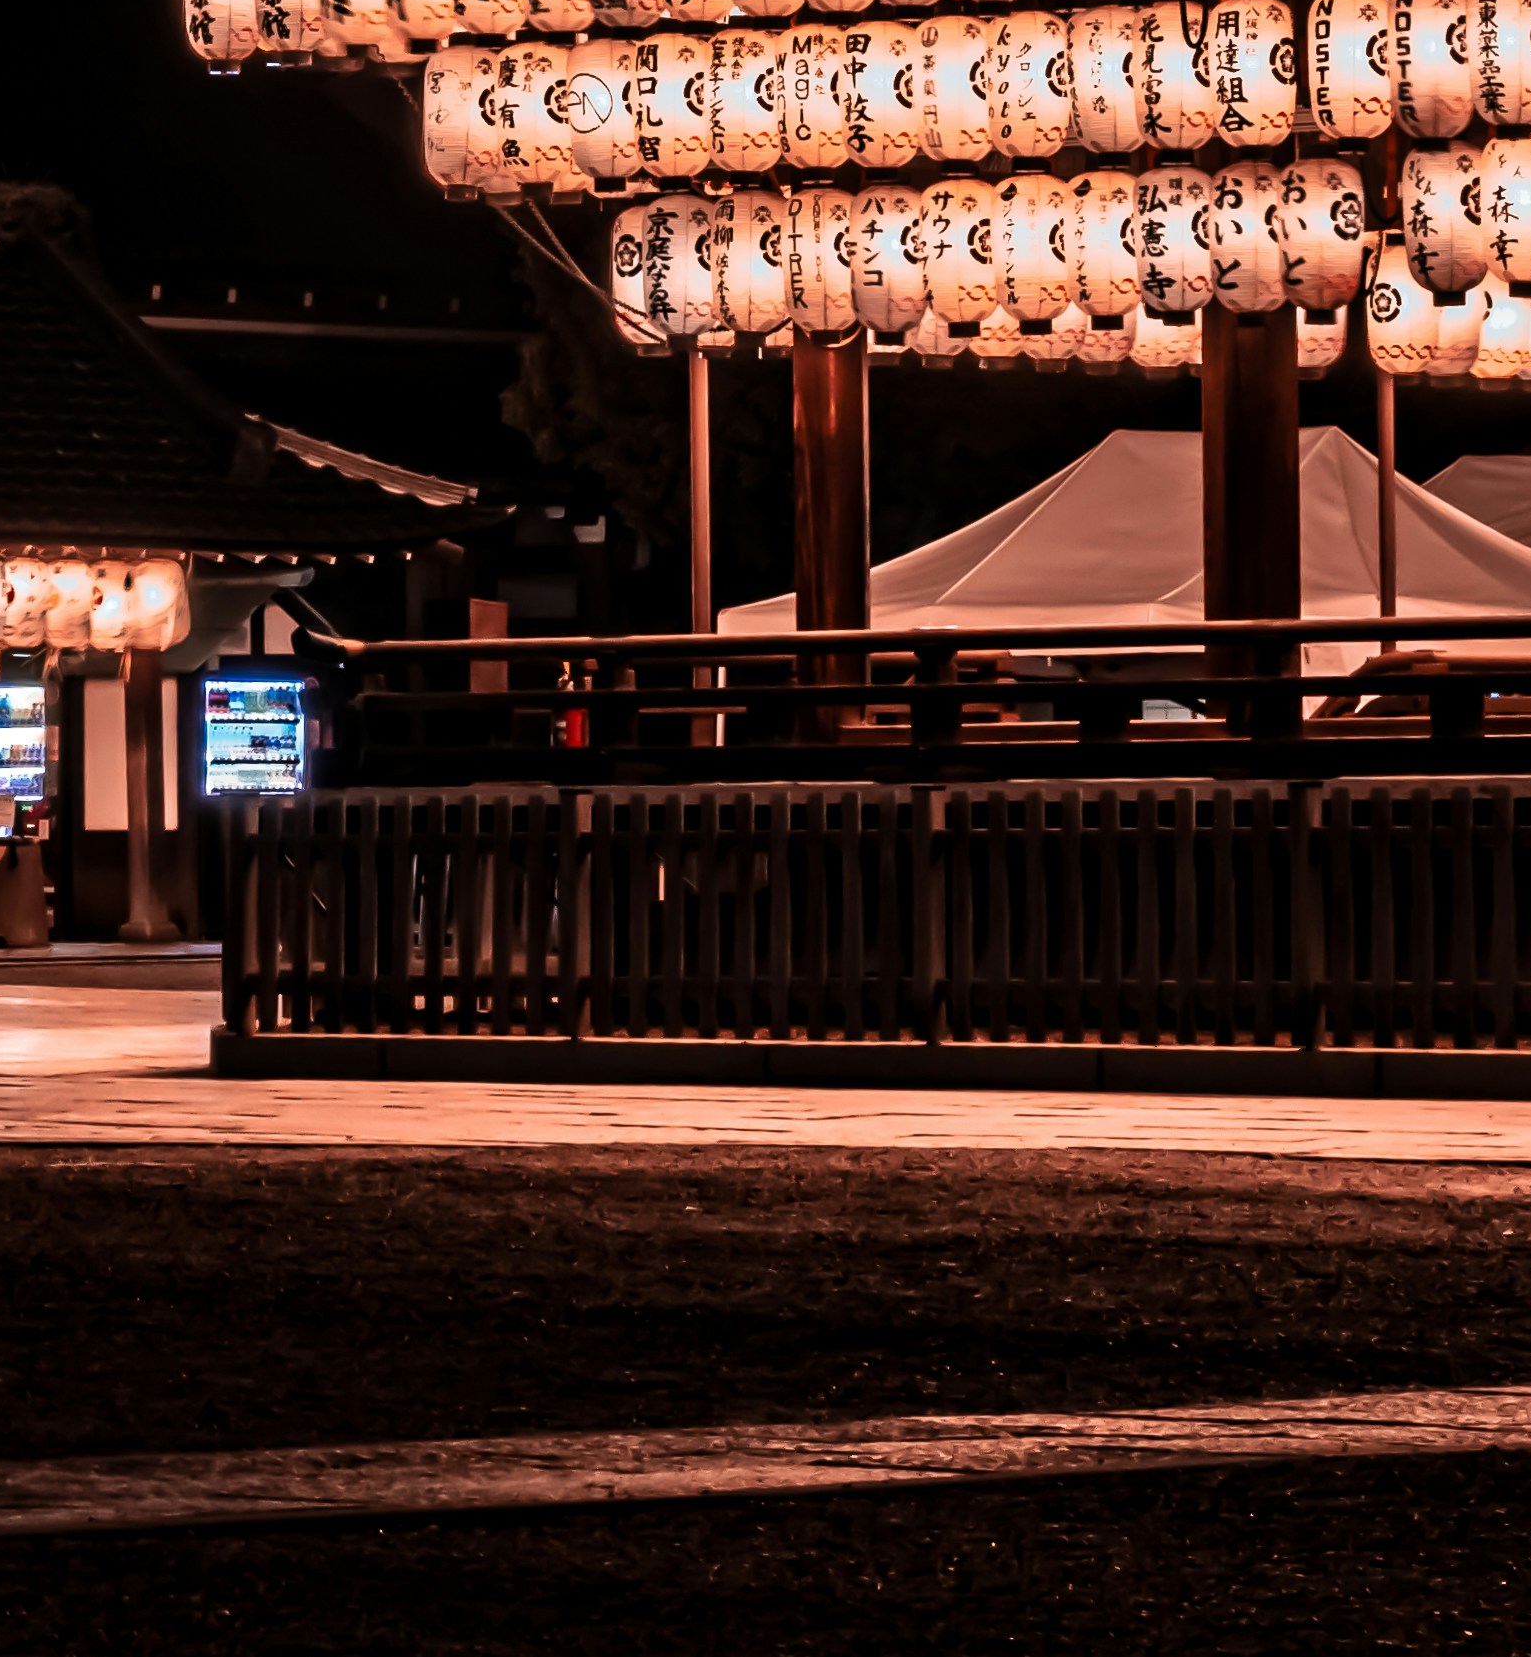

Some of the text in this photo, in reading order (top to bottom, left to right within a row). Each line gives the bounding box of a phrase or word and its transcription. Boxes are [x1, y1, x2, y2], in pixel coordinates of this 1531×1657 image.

[792, 35, 813, 141] Magic
[1215, 10, 1254, 132] 用達組合
[1314, 0, 1337, 128] NOSTER
[860, 196, 887, 287] パチンコ
[931, 191, 955, 260] サウナ
[1138, 184, 1177, 300] 弘憲寺
[1213, 176, 1243, 290] おいと
[1488, 186, 1520, 272] 森幸
